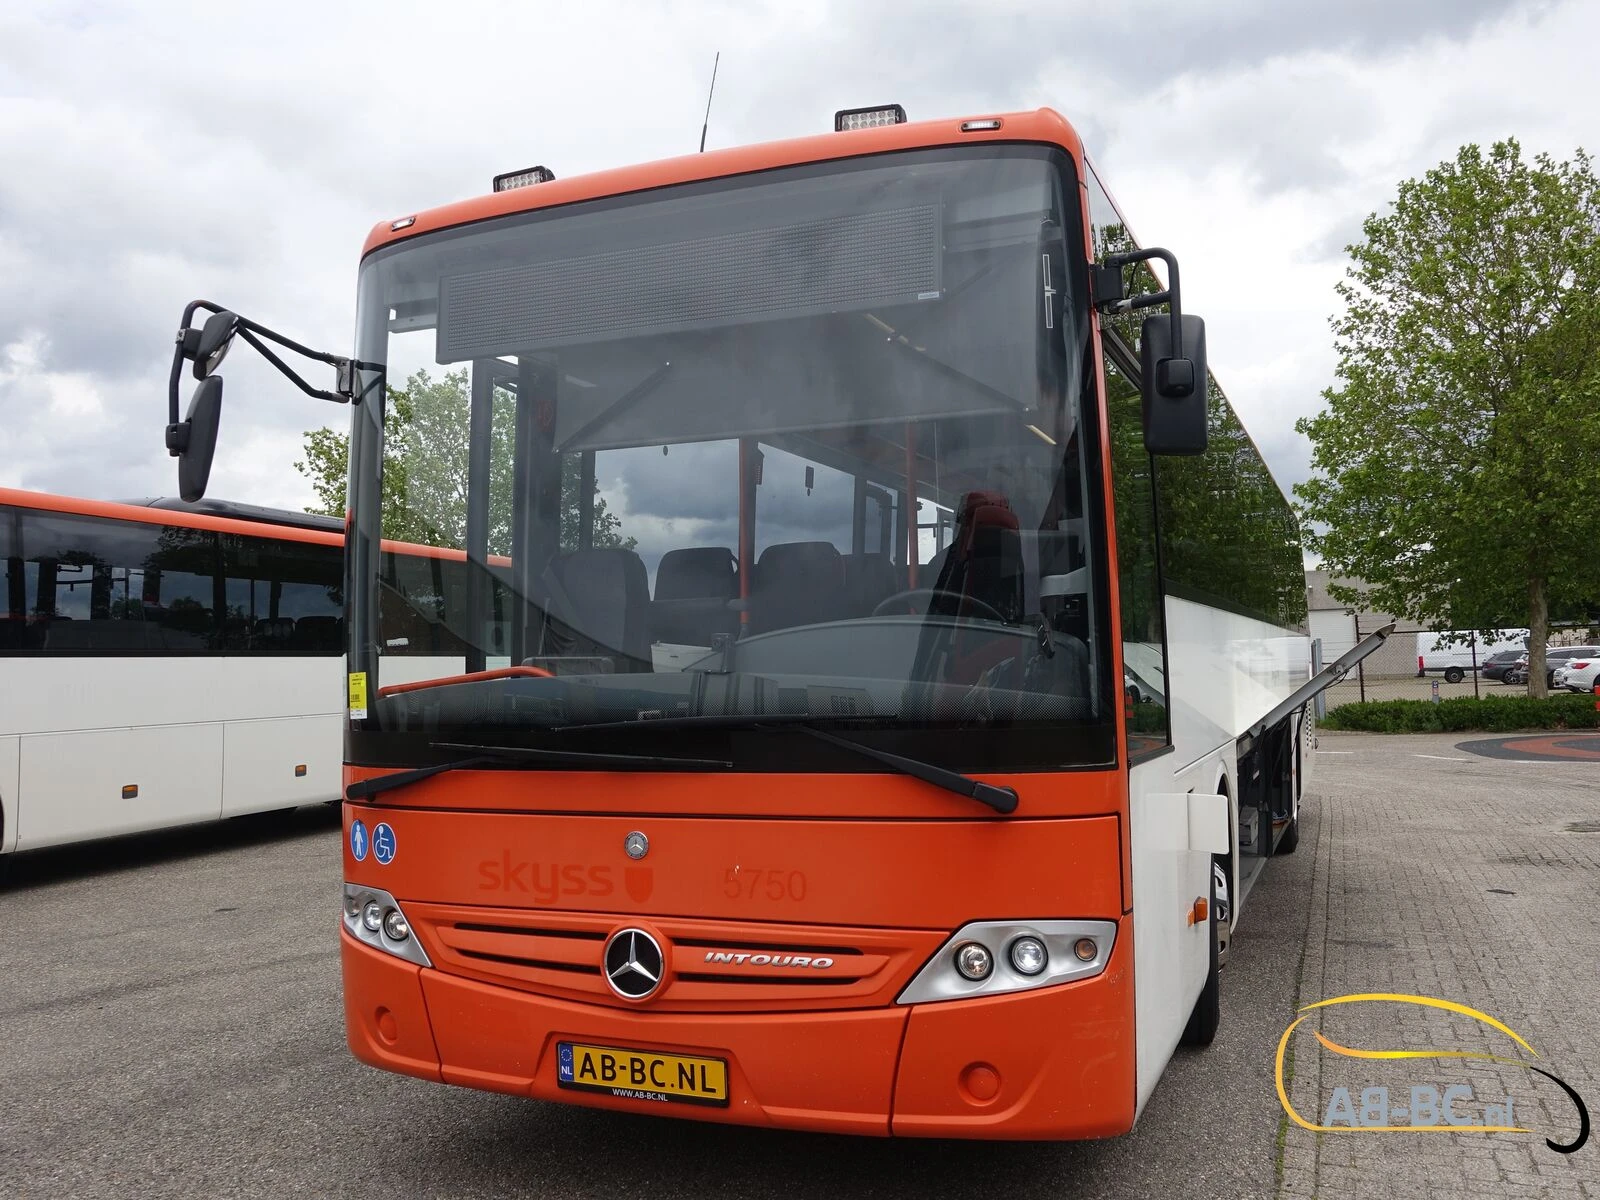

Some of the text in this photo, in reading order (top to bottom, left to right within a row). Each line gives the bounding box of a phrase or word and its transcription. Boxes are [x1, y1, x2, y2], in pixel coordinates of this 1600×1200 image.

[478, 851, 614, 905] skyss
[723, 868, 808, 902] 5750
[704, 952, 834, 969] INTOURO
[561, 1066, 573, 1076] NL
[579, 1052, 717, 1094] AB-BC.NL
[612, 1088, 668, 1102] WWW.AB-BC.NL
